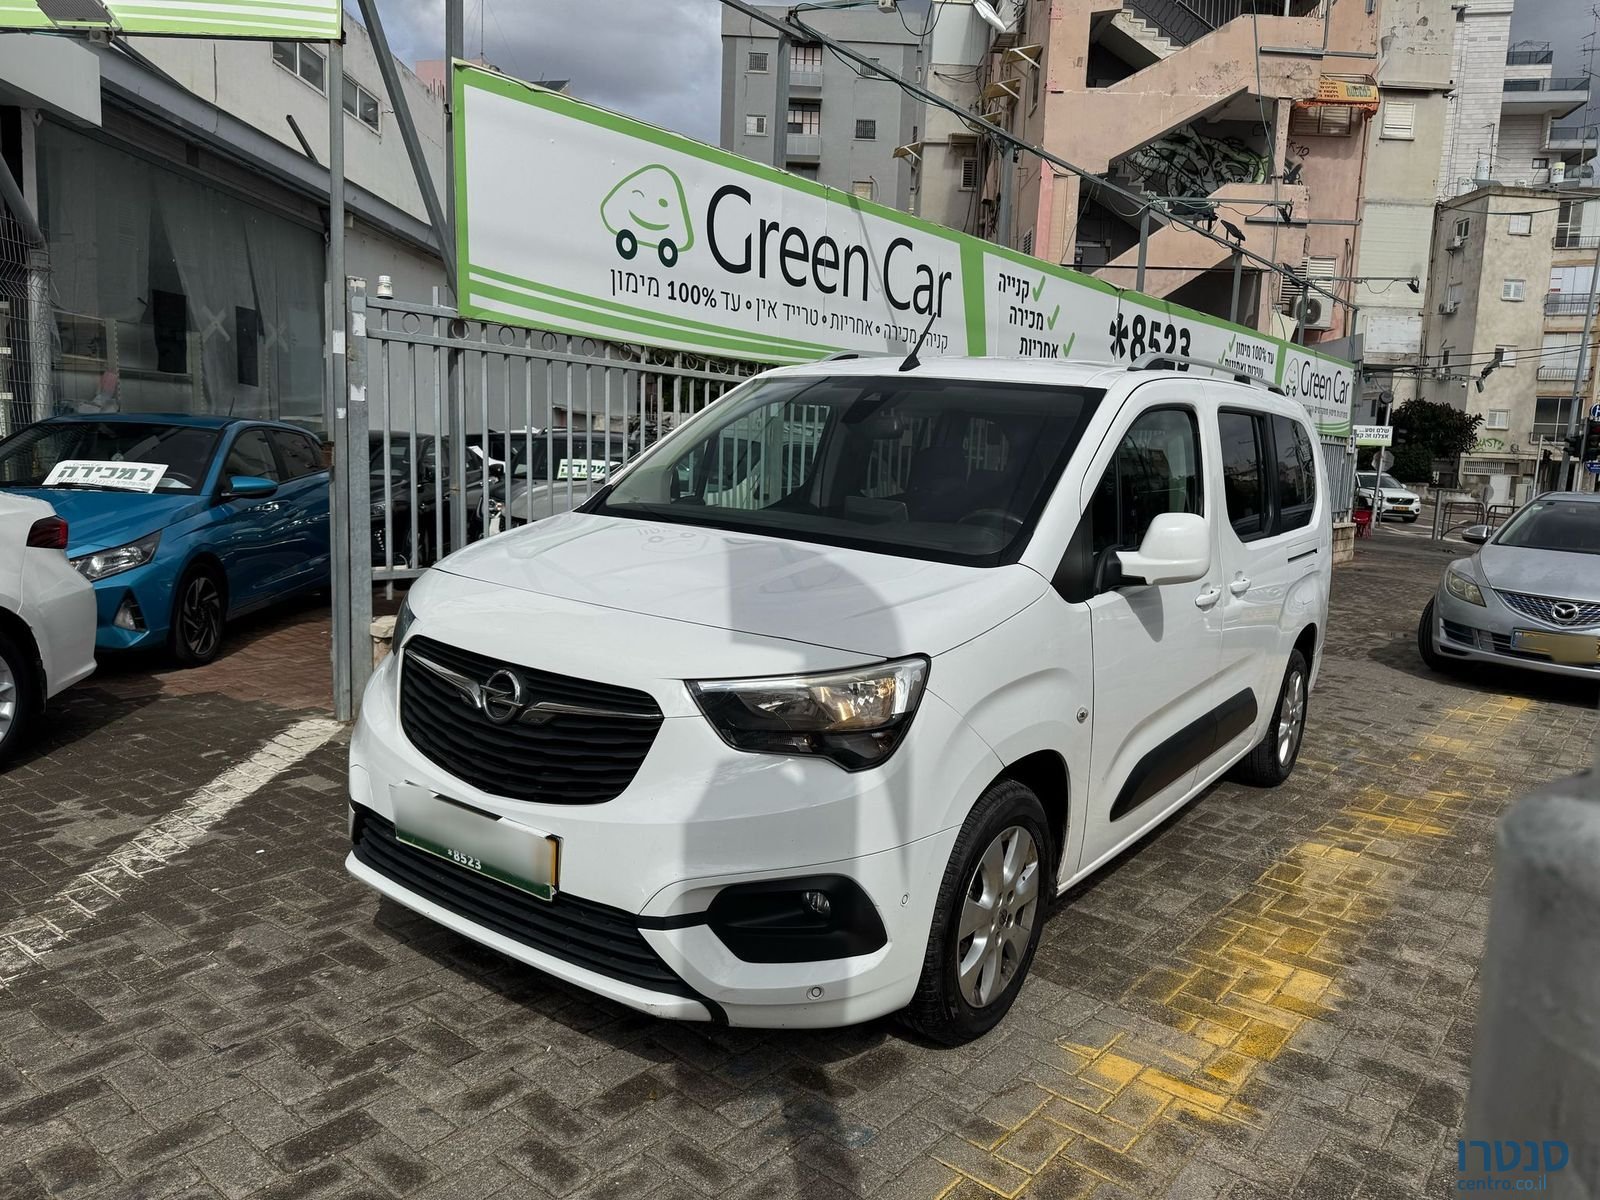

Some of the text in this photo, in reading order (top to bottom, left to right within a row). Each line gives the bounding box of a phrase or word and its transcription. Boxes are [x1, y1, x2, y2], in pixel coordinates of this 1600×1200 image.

[706, 184, 952, 318] Green Car
[610, 269, 660, 297] מימון
[667, 280, 717, 309] 100%
[998, 273, 1030, 304] קנייה
[721, 291, 741, 312] עד
[756, 298, 777, 322] אין
[783, 303, 819, 326] טרייד
[830, 312, 873, 337] אחריות
[1009, 305, 1044, 331] מכירה
[884, 323, 917, 344] מכירה
[1019, 336, 1059, 359] אחריות
[1301, 360, 1349, 404] Green Car
[58, 466, 155, 481] למכירה
